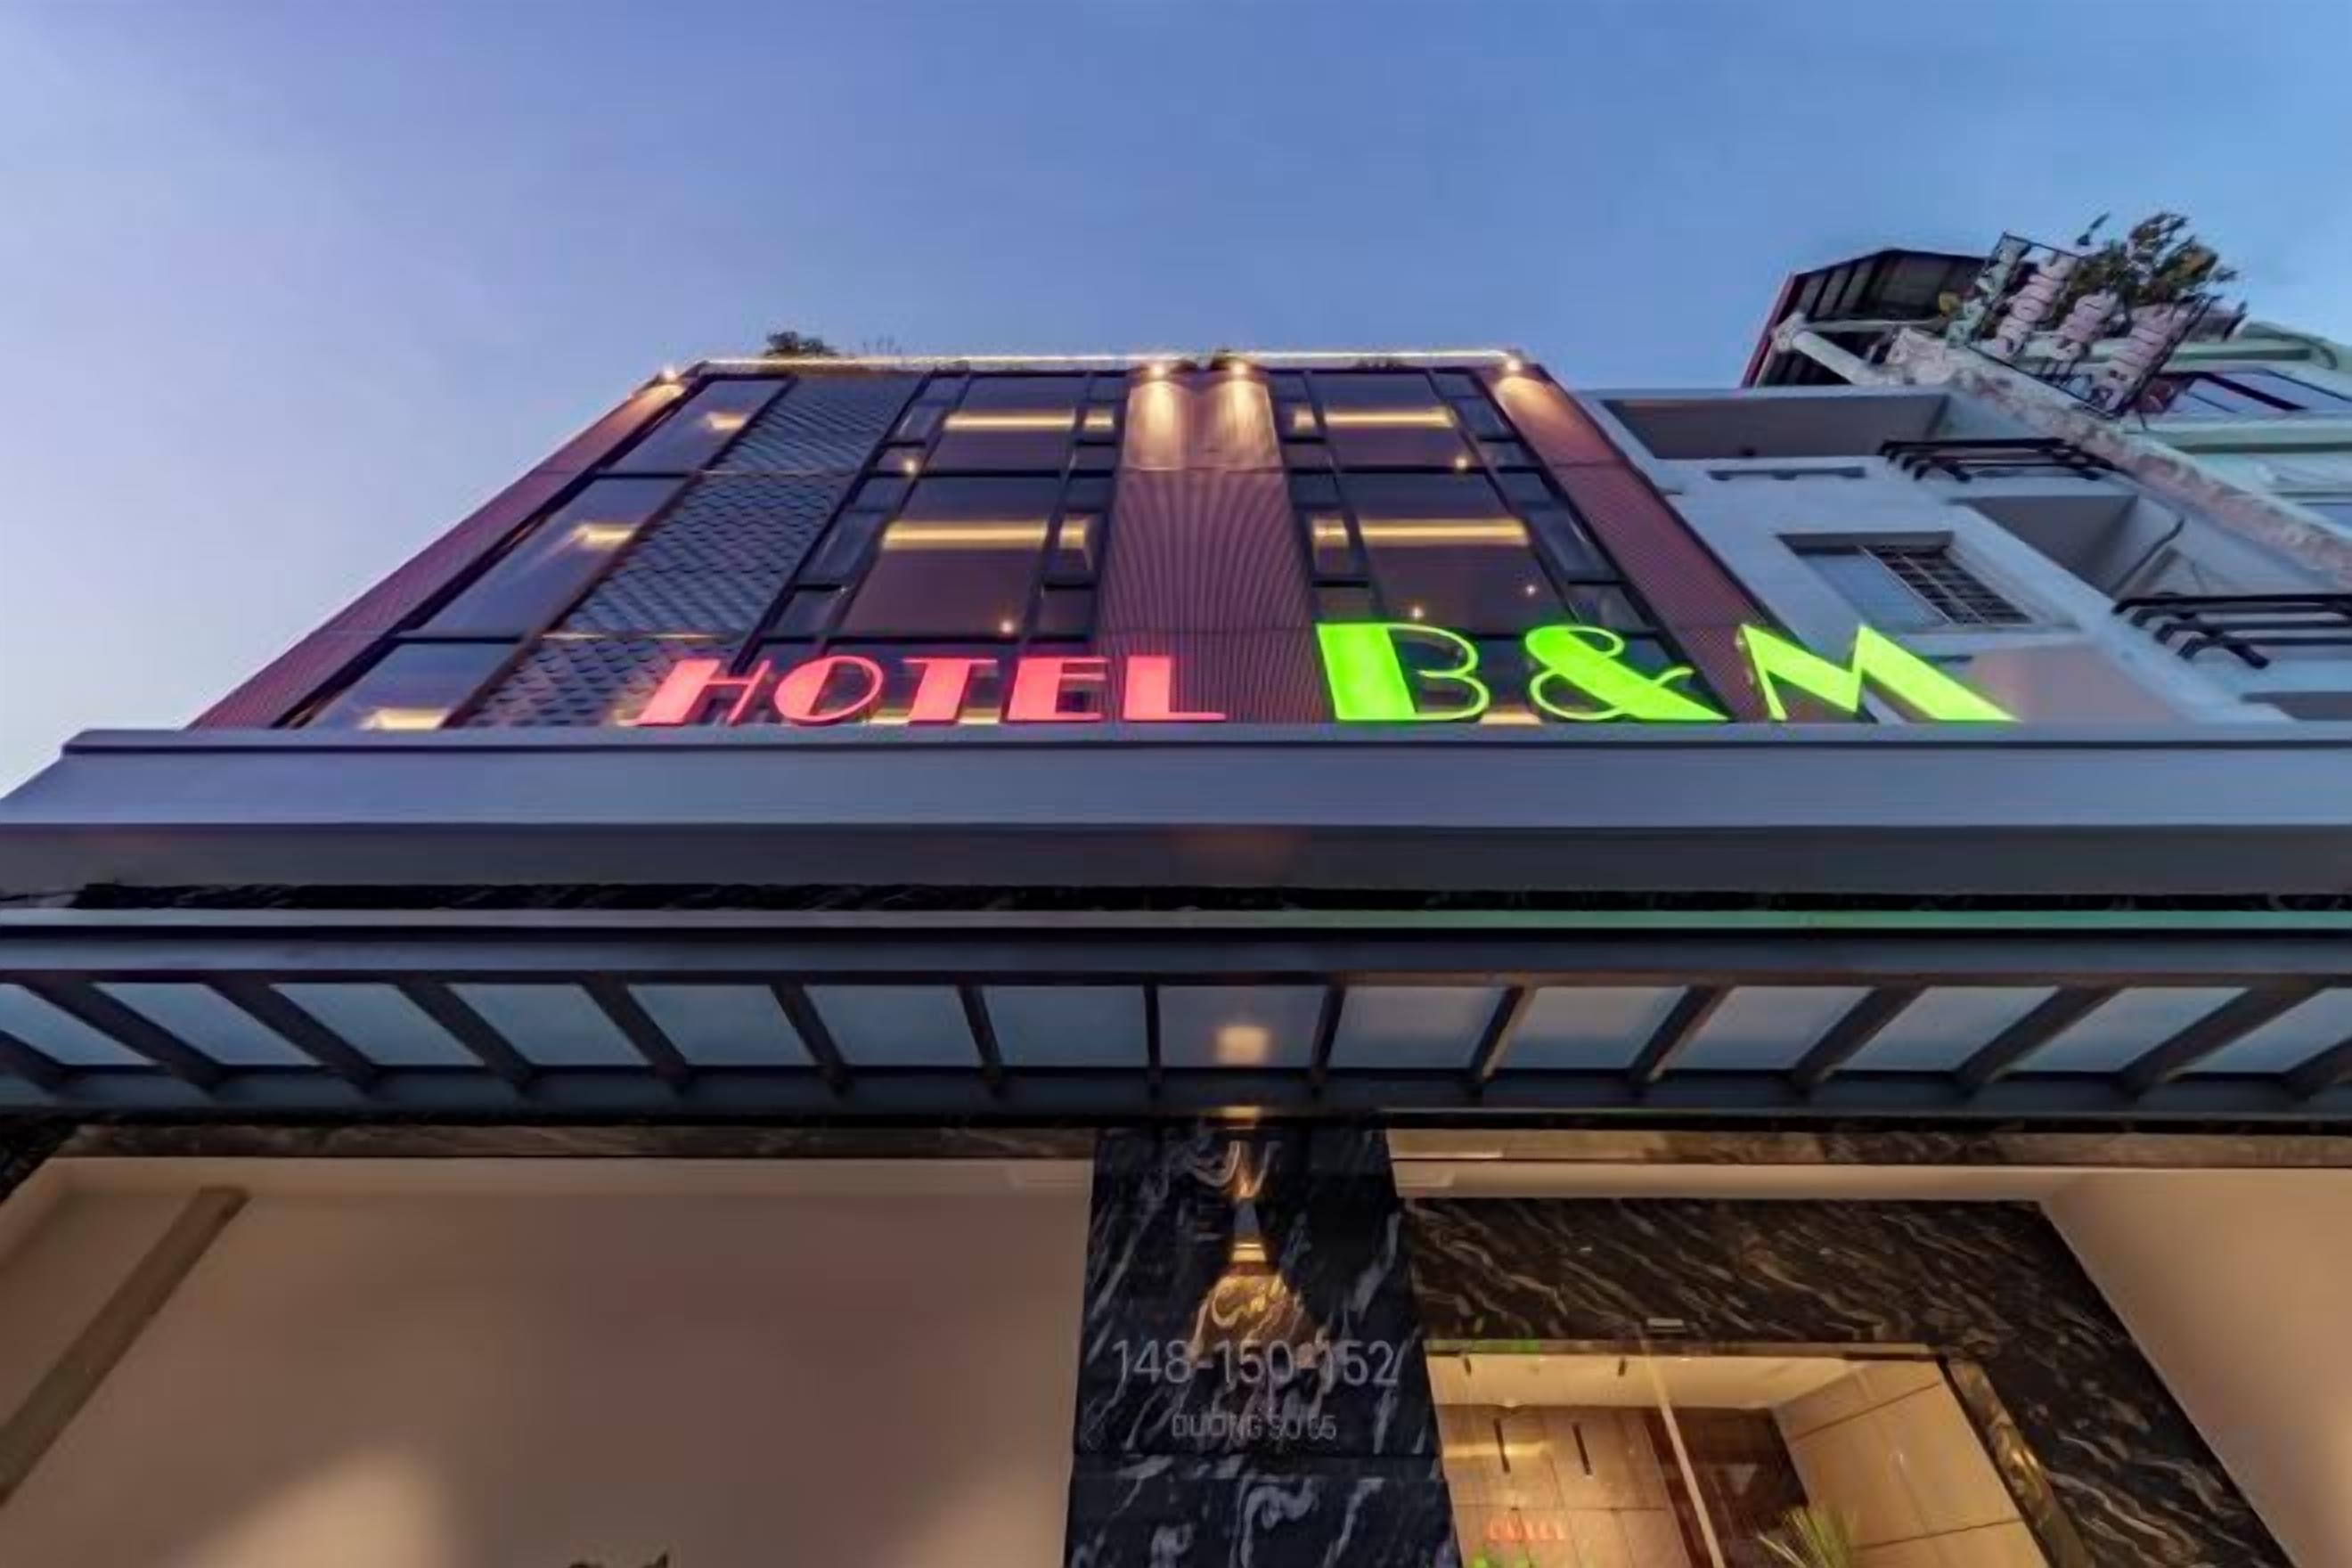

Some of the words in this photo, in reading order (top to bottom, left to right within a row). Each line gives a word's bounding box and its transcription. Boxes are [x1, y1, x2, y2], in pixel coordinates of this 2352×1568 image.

[617, 655, 1226, 726] HOTEL
[1316, 622, 2018, 723] B&M
[1112, 1339, 1398, 1387] 148-150-152
